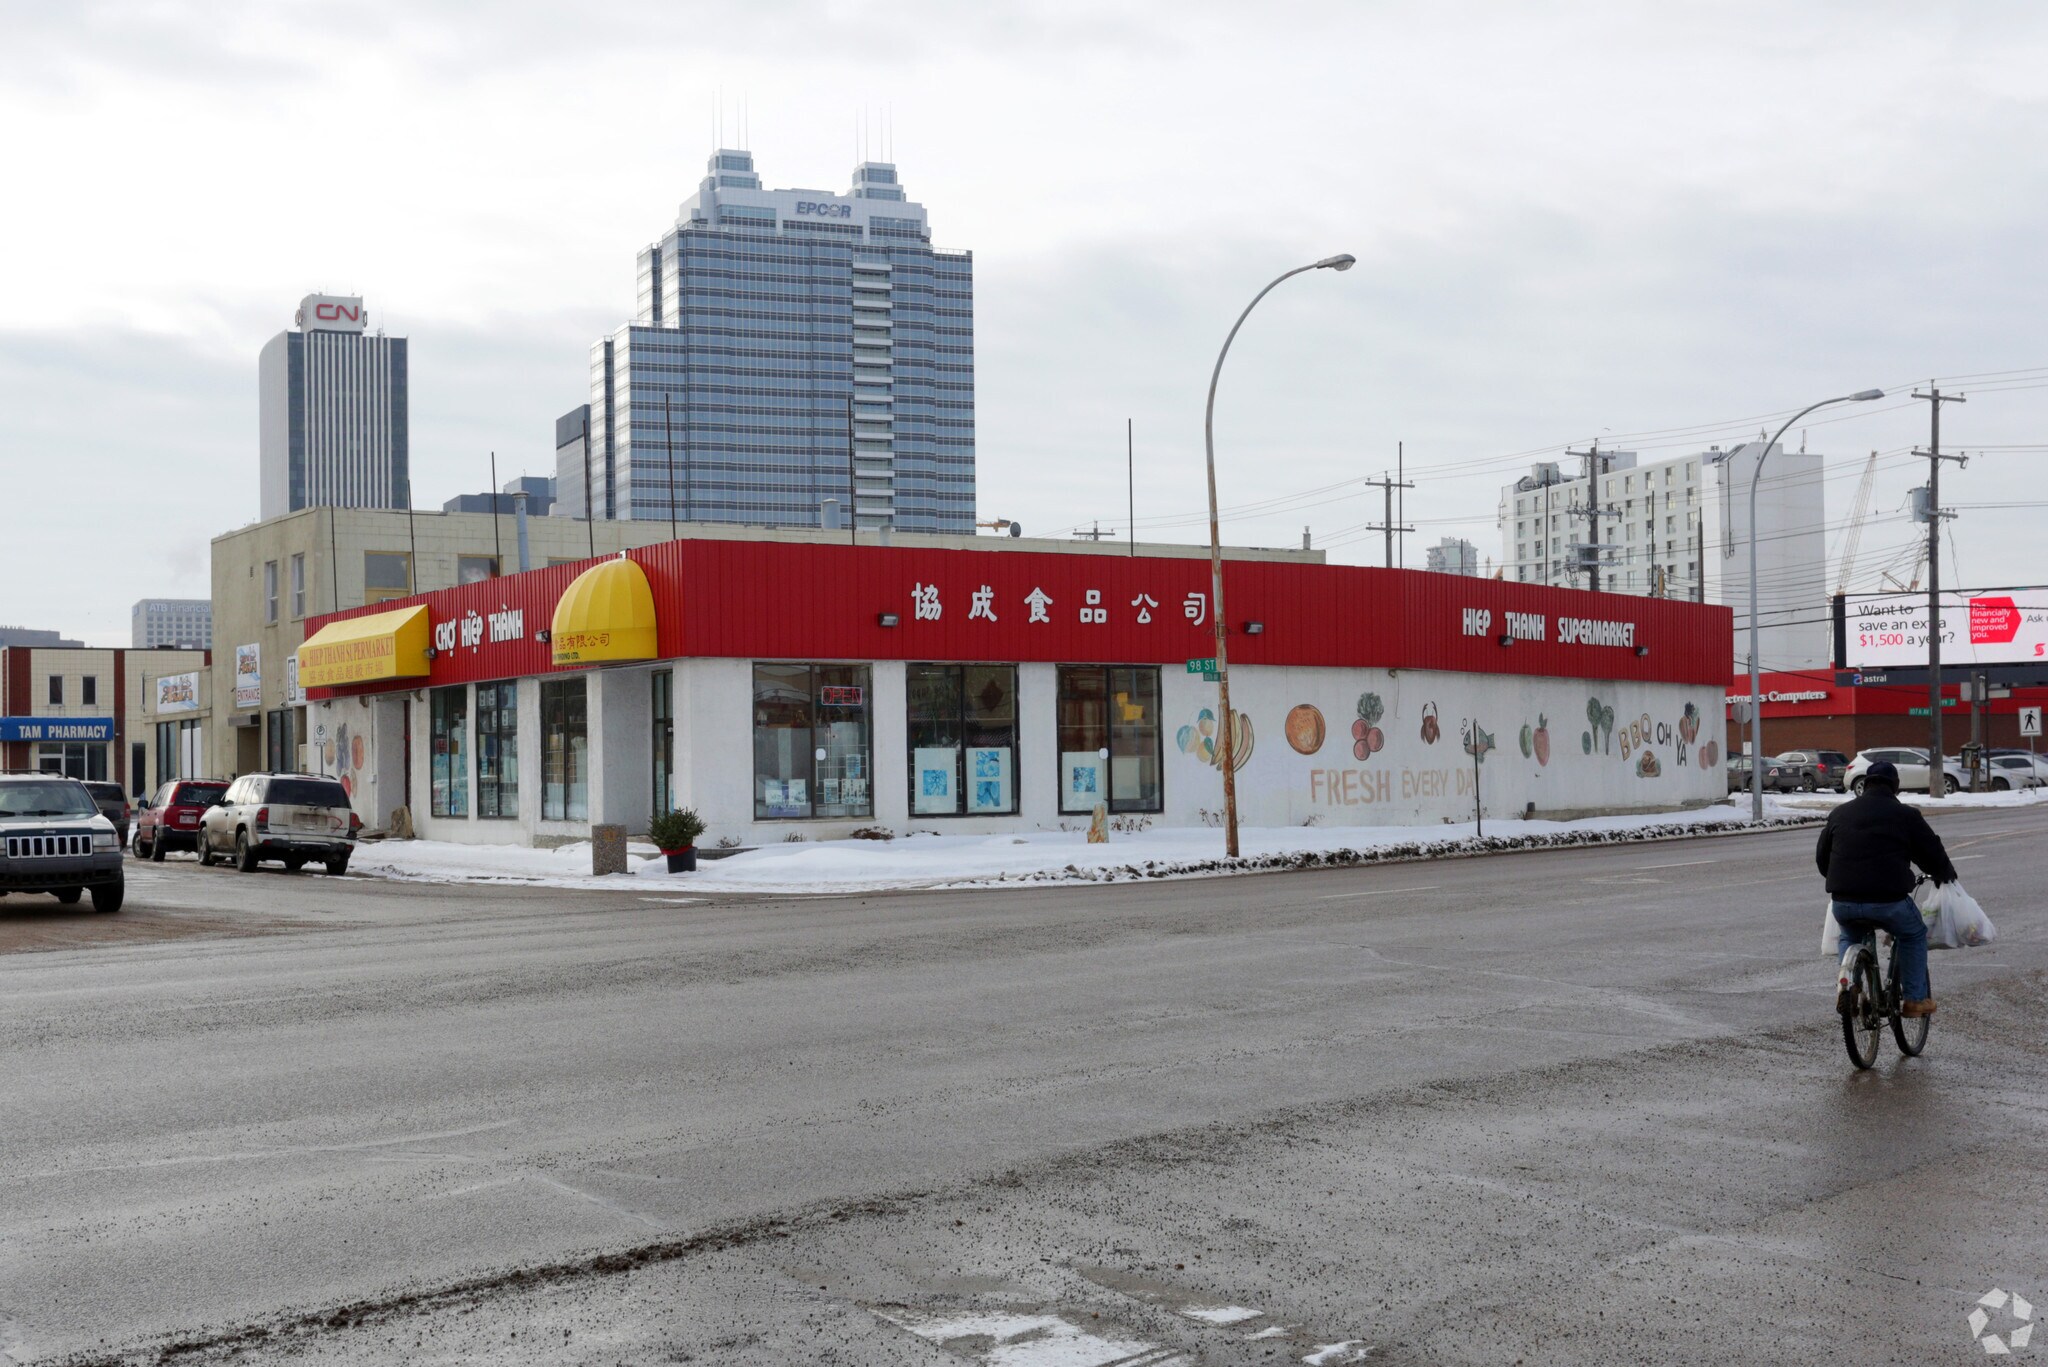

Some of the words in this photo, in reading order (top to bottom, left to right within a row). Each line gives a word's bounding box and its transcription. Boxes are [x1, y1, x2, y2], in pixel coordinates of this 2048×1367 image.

[316, 303, 359, 322] CN
[149, 603, 168, 612] ATB
[171, 603, 211, 613] Financial
[911, 582, 1206, 626] 協成食品公司
[1859, 604, 1896, 616] Want
[1900, 604, 1914, 615] to
[1971, 608, 2011, 618] financially
[2026, 614, 2043, 623] Ask
[488, 603, 524, 643] THÀNH
[1462, 607, 1491, 637] HIEP
[1504, 611, 1546, 642] THANH
[1557, 616, 1635, 648] SUPERMARKET
[1859, 621, 1888, 632] save
[1891, 620, 1908, 631] an
[1911, 619, 1947, 630] exa
[1971, 623, 2008, 632] improved
[1859, 633, 1904, 648] $1,500
[1907, 635, 1915, 645] a
[1918, 631, 1955, 648] yer?
[1971, 631, 1990, 640] you.
[309, 647, 325, 667] HIEP
[325, 642, 346, 665] THANH
[346, 636, 394, 662] SUPERMARKET
[1190, 660, 1202, 671] 98
[1204, 659, 1215, 671] ST
[1863, 674, 1887, 683] astral
[823, 687, 861, 704] OPEN
[1768, 690, 1827, 704] Computers
[18, 725, 42, 739] TAM
[48, 725, 107, 739] PHARMACY
[1657, 722, 1672, 747] OH
[1676, 734, 1687, 767] YA
[1310, 769, 1391, 805] FRESH
[1402, 767, 1449, 799] EVERY
